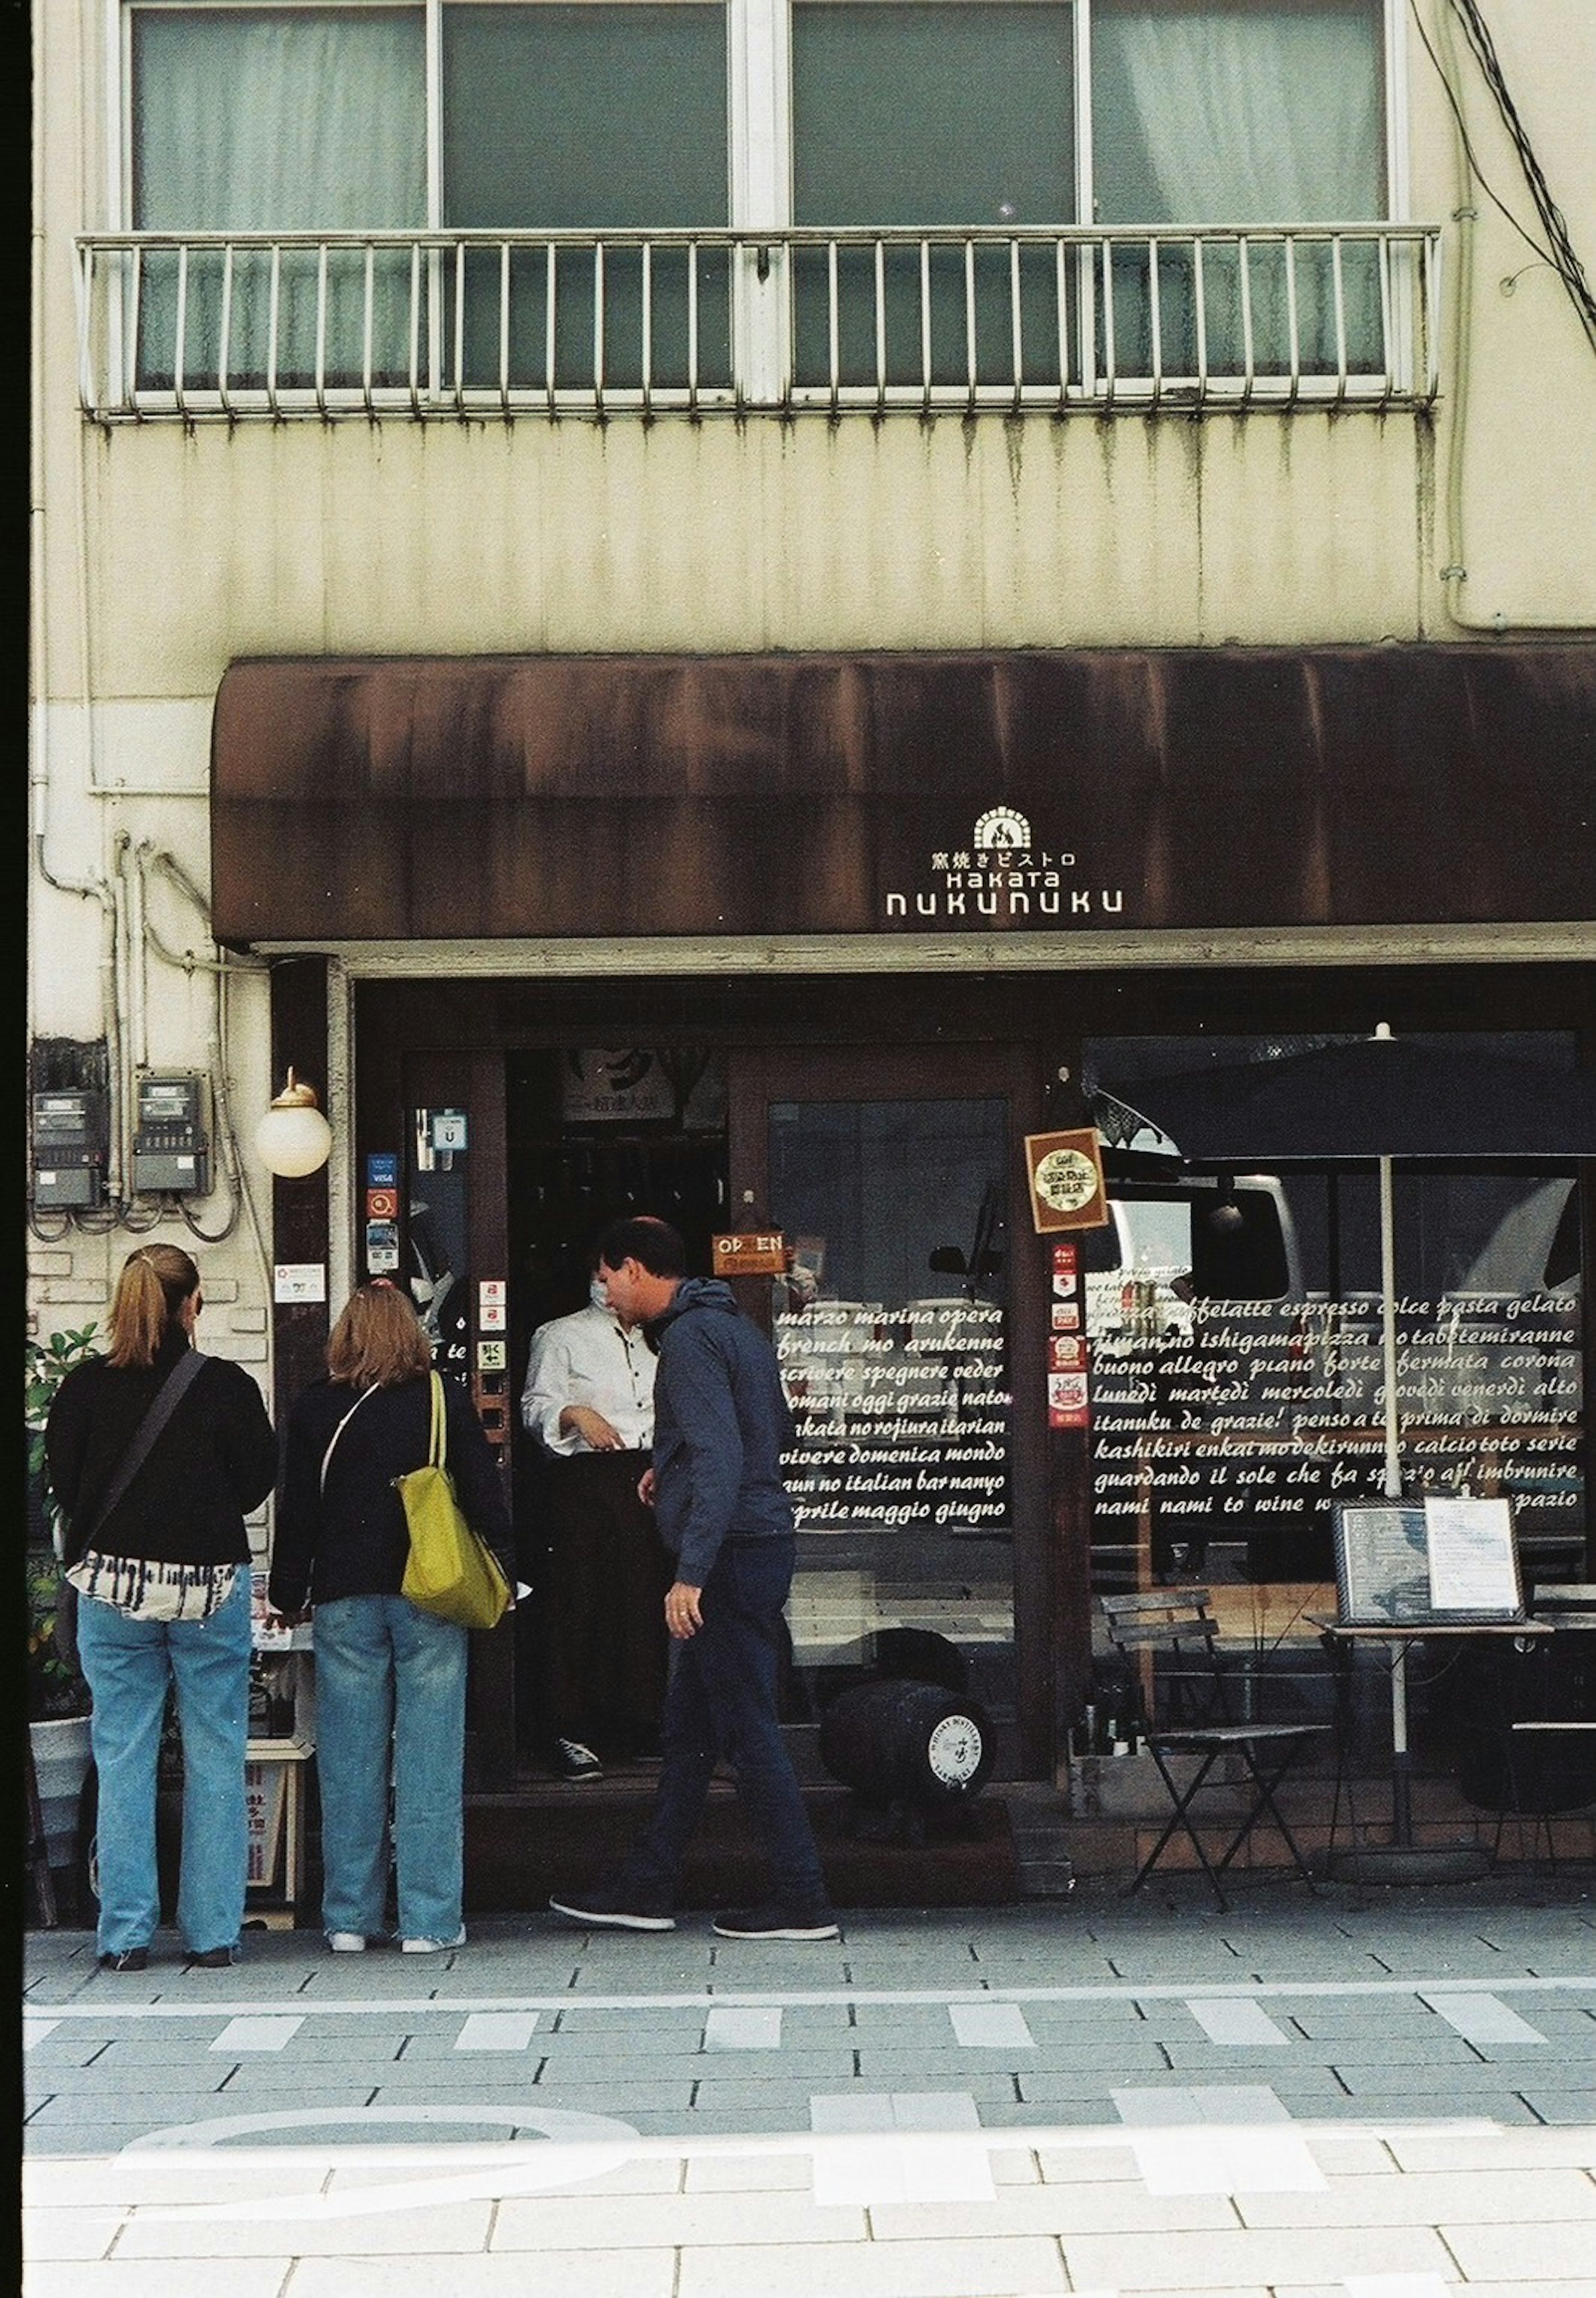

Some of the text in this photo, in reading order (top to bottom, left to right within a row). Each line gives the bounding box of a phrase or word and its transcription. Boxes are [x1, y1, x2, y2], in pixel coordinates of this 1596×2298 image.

[931, 851, 1076, 870] 窯焼きビストロ
[777, 1308, 1002, 1332] marzo marina opera
[1279, 1301, 1369, 1324] espresso
[1506, 1294, 1576, 1320] gelato
[776, 1332, 1004, 1360] french mo arukenne
[862, 1364, 948, 1388] spegnere
[1093, 1356, 1154, 1376] buono
[1249, 1357, 1315, 1381] piano
[1324, 1350, 1381, 1378] forte
[1396, 1349, 1488, 1377] fermata
[1500, 1353, 1576, 1369] corona
[1092, 1382, 1157, 1403] lunedì
[1168, 1380, 1249, 1401] martedì
[1261, 1379, 1364, 1401] mercoledì
[1451, 1375, 1525, 1397] venerdì
[1533, 1377, 1578, 1395] alto
[852, 1392, 893, 1414] oggi
[897, 1392, 956, 1414] grazie
[850, 1422, 872, 1436] no
[873, 1417, 938, 1443] rojiura
[940, 1417, 1005, 1436] itarian
[1093, 1409, 1171, 1432] itanuku
[1180, 1409, 1202, 1431] de
[1210, 1406, 1286, 1436] grazie!
[1292, 1412, 1351, 1436] penso
[1400, 1411, 1463, 1433] prima
[1471, 1405, 1490, 1425] di
[1499, 1404, 1578, 1424] dormire
[778, 1441, 1005, 1465] vivere domenica mondo
[1094, 1436, 1191, 1459] kashikiri
[1527, 1437, 1577, 1452] serie
[818, 1478, 841, 1493] no
[845, 1472, 912, 1492] italian
[1094, 1465, 1200, 1494] guardando
[1209, 1465, 1227, 1485] il
[1236, 1464, 1277, 1485] sole
[1286, 1461, 1321, 1484] che
[1330, 1461, 1357, 1489] fa
[1477, 1459, 1577, 1480] imbrunire
[850, 1501, 931, 1525] maggio
[934, 1500, 1006, 1524] giugno
[1094, 1497, 1150, 1515] nami
[1160, 1496, 1213, 1514] nami
[1224, 1496, 1245, 1513] to
[1254, 1495, 1305, 1512] wine
